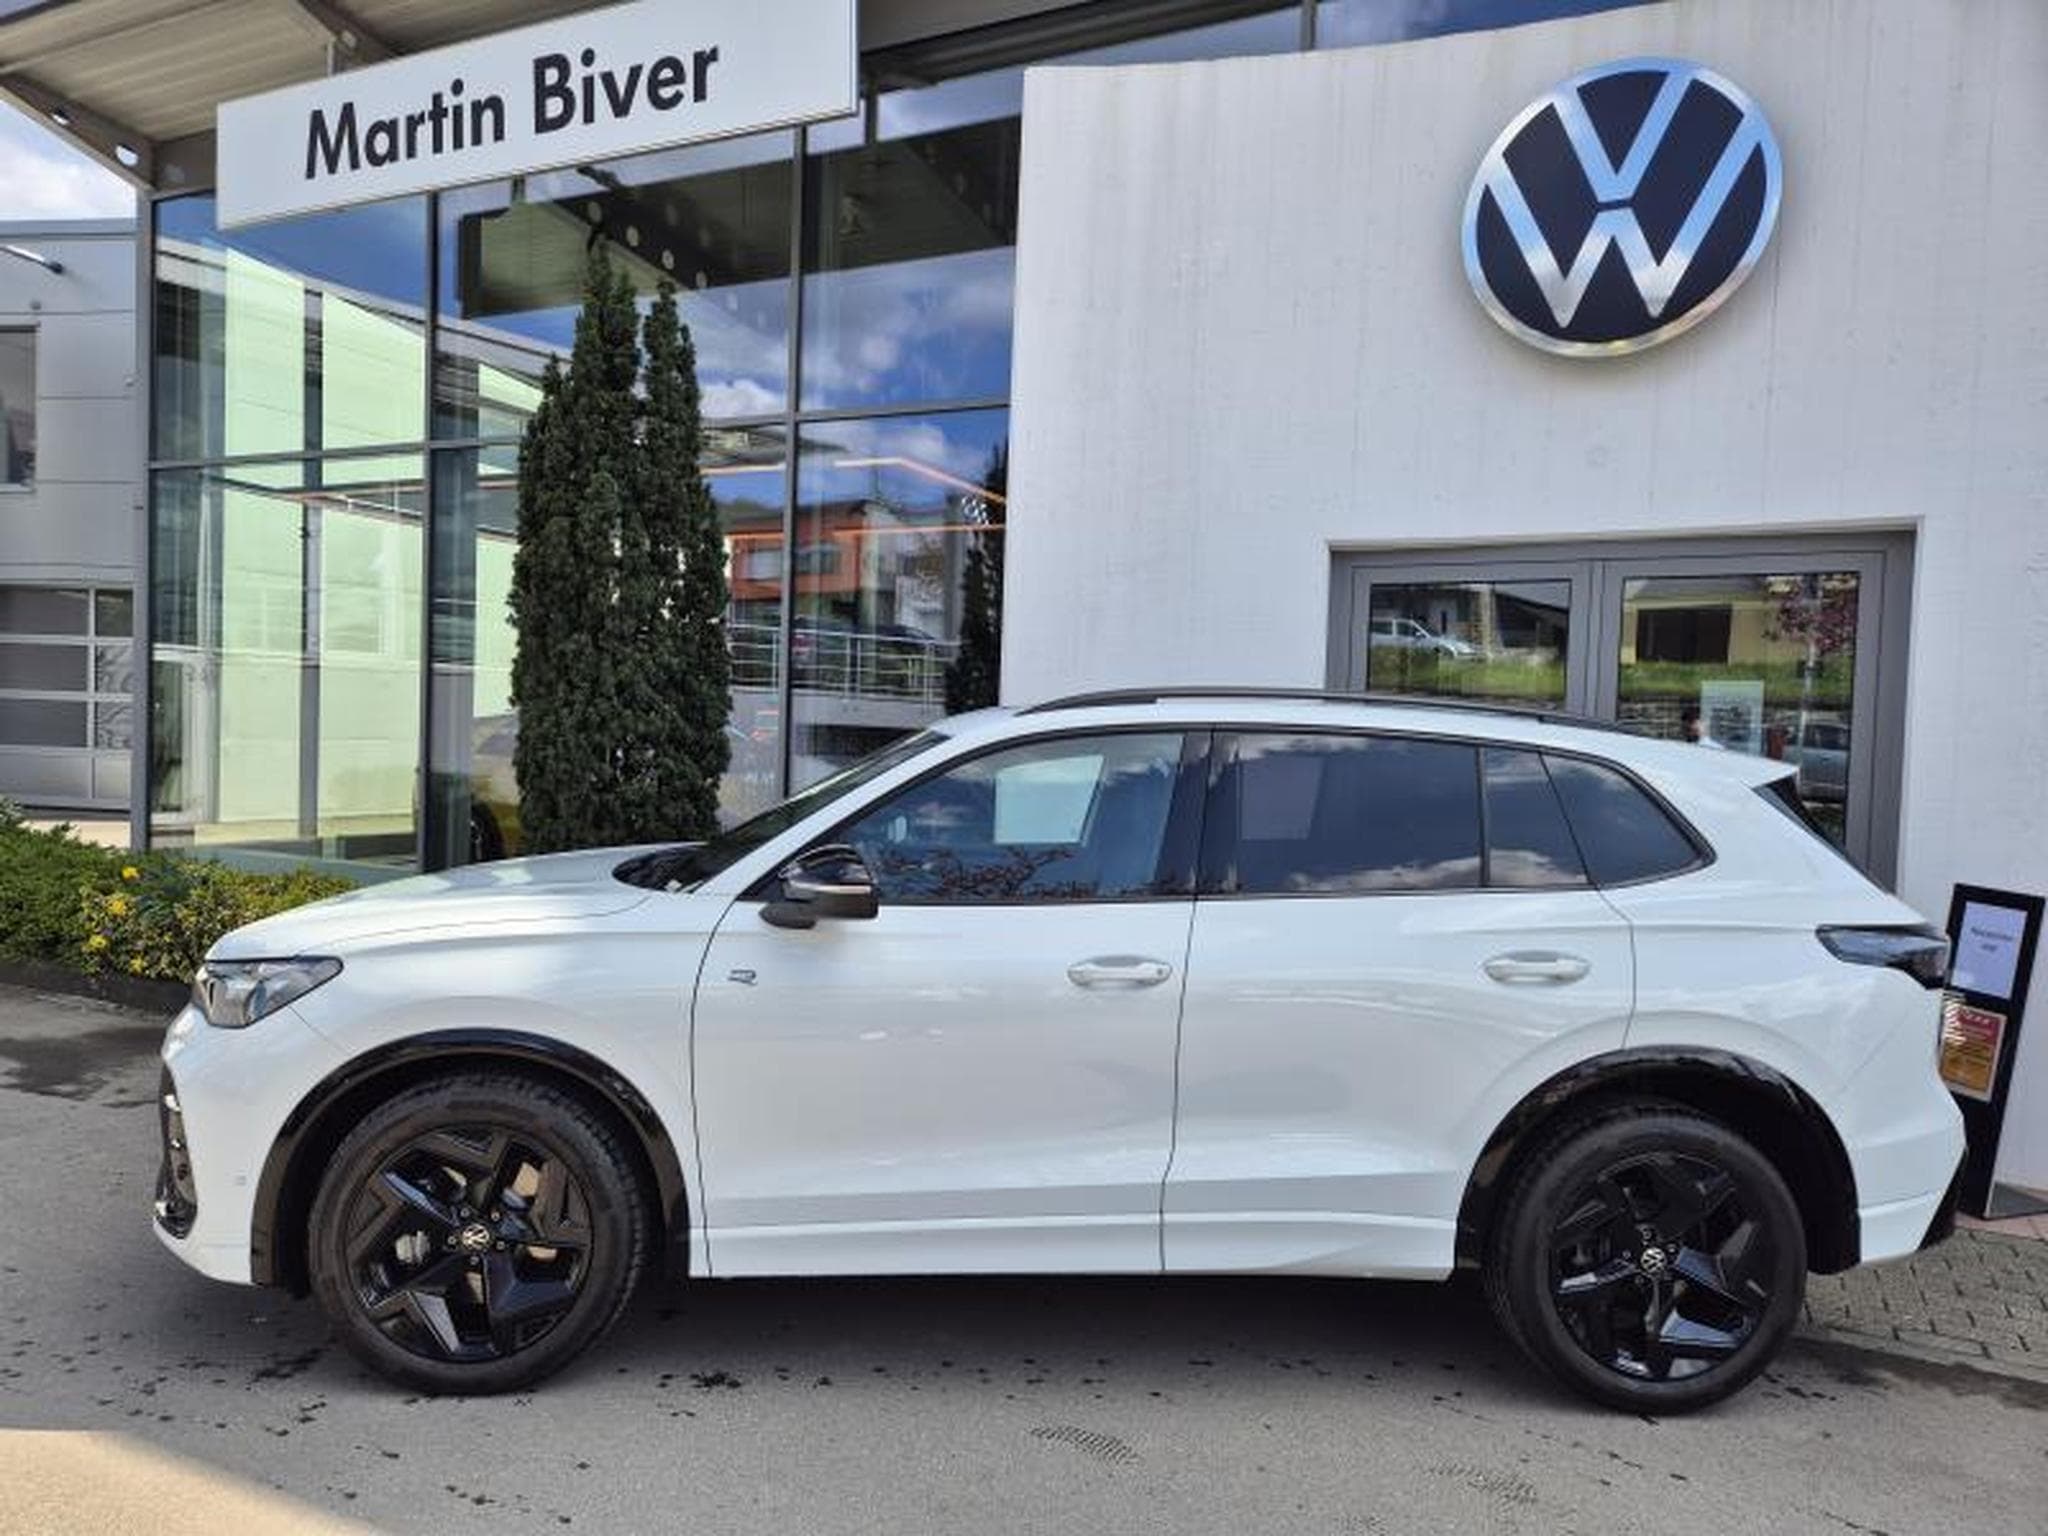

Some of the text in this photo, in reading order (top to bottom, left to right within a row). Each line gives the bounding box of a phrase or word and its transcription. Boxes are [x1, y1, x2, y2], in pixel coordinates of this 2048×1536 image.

[305, 44, 718, 180] Martin Biver
[1470, 62, 1774, 340] VW
